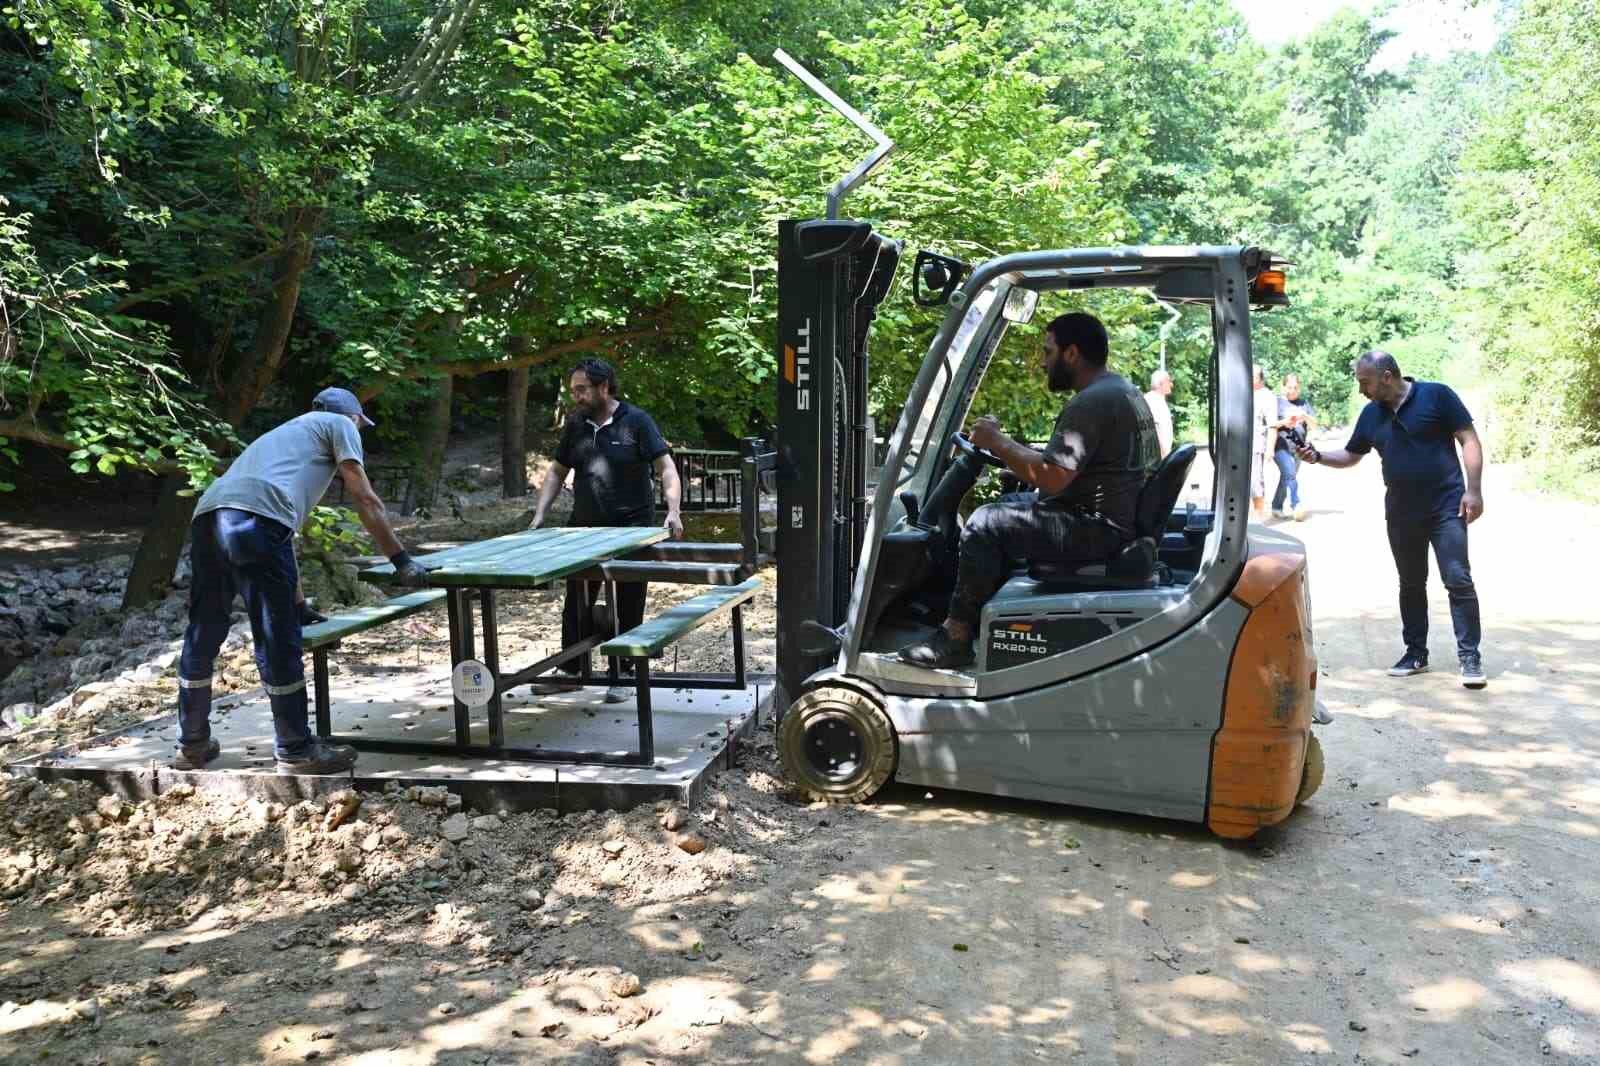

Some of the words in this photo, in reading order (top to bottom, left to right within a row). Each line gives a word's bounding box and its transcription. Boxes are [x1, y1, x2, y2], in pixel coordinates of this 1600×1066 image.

[797, 318, 810, 410] STILL
[993, 629, 1047, 642] STILL
[993, 642, 1047, 654] RX20-20
